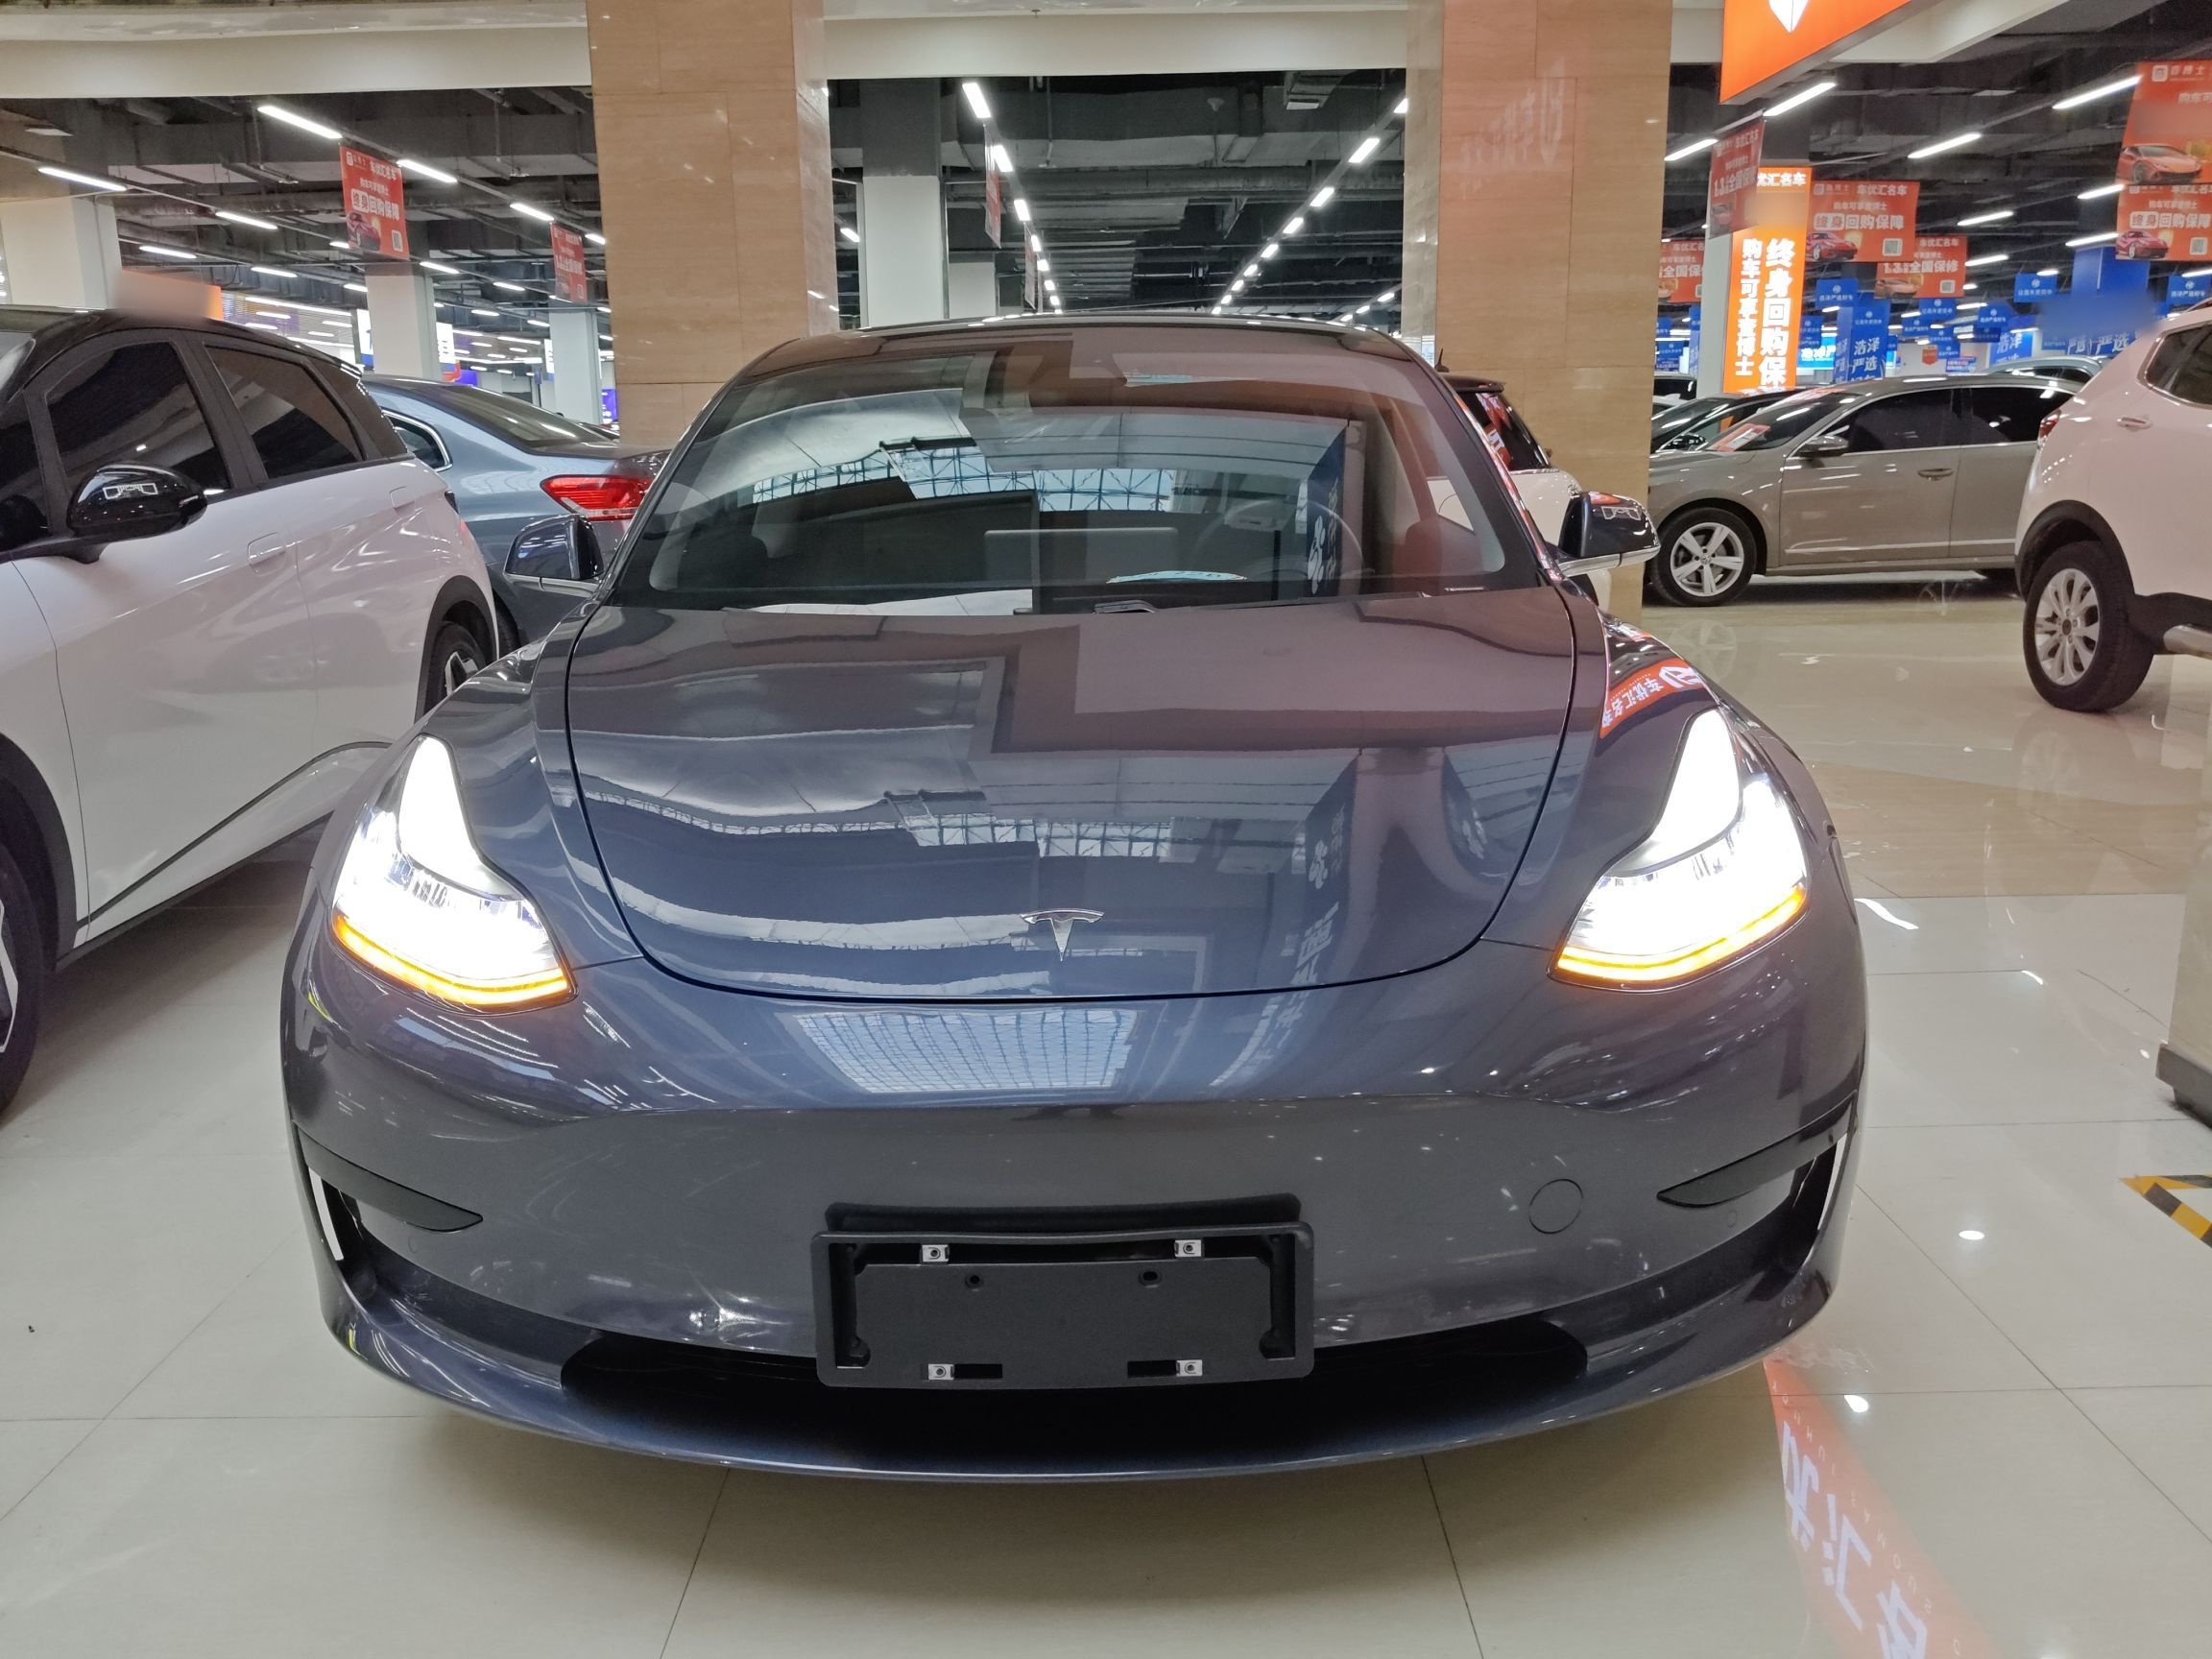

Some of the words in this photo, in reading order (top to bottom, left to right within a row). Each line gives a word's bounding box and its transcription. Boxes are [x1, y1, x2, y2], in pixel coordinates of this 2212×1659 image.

[1815, 214, 1904, 229] 终身回购保障
[2130, 213, 2211, 228] 终身回购保障
[1735, 238, 1763, 376] 购车可享查博士
[1758, 238, 1795, 393] 终身回购保
[1853, 337, 1880, 356] 浩泽
